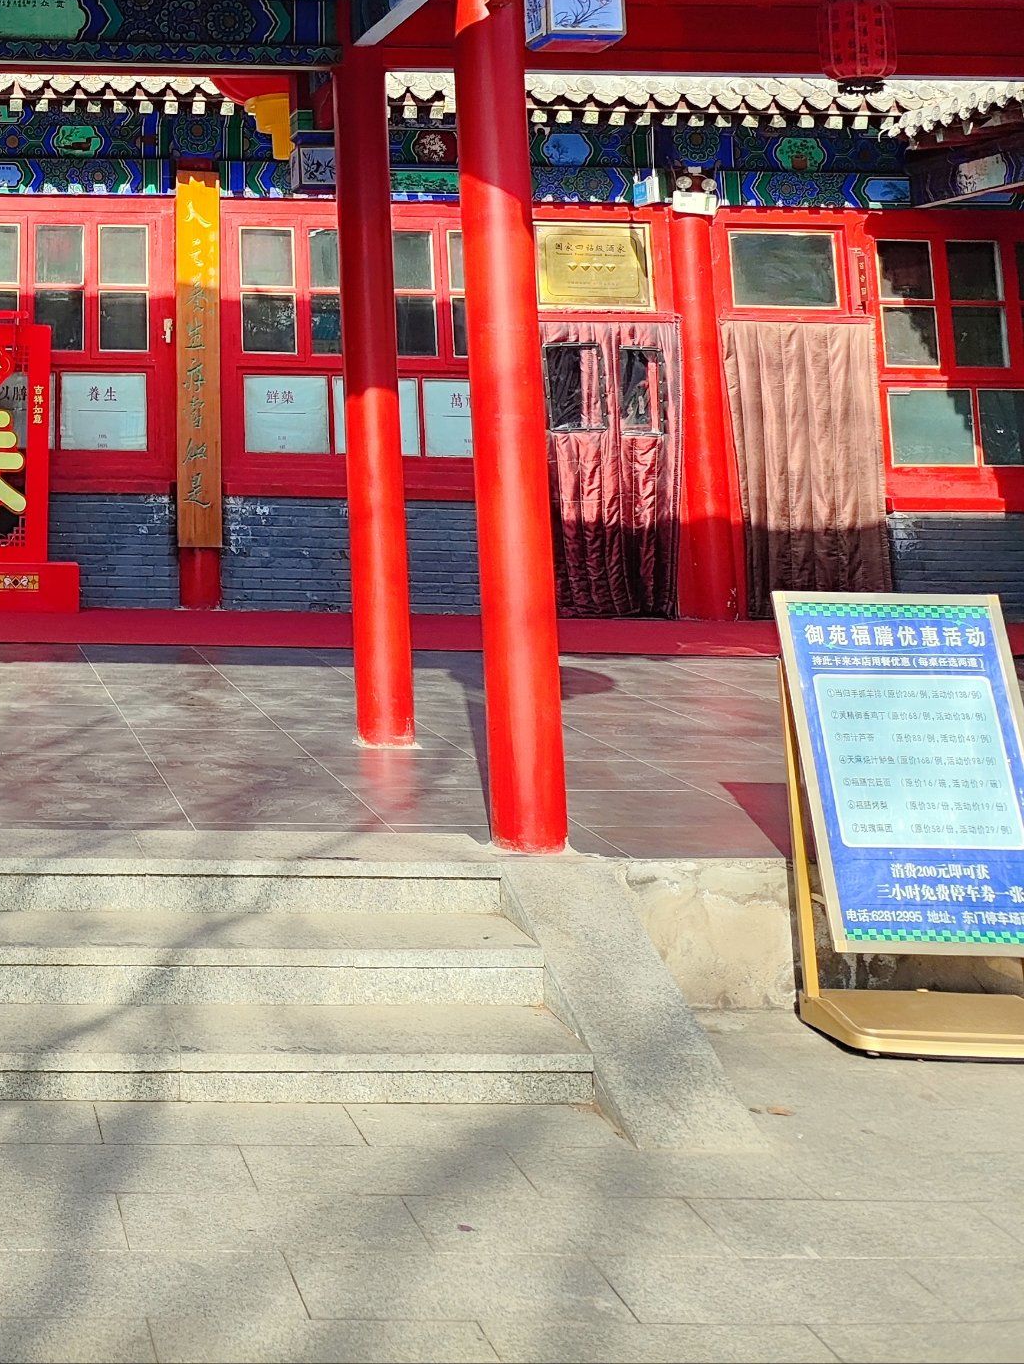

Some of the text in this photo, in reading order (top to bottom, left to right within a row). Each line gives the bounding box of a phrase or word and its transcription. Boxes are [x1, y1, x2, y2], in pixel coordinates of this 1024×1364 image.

[33, 385, 44, 424] 吉祥如意
[87, 386, 118, 402] 養生
[805, 624, 986, 649] 御苑福膳优惠活动
[891, 863, 990, 880] 消费200元即可获
